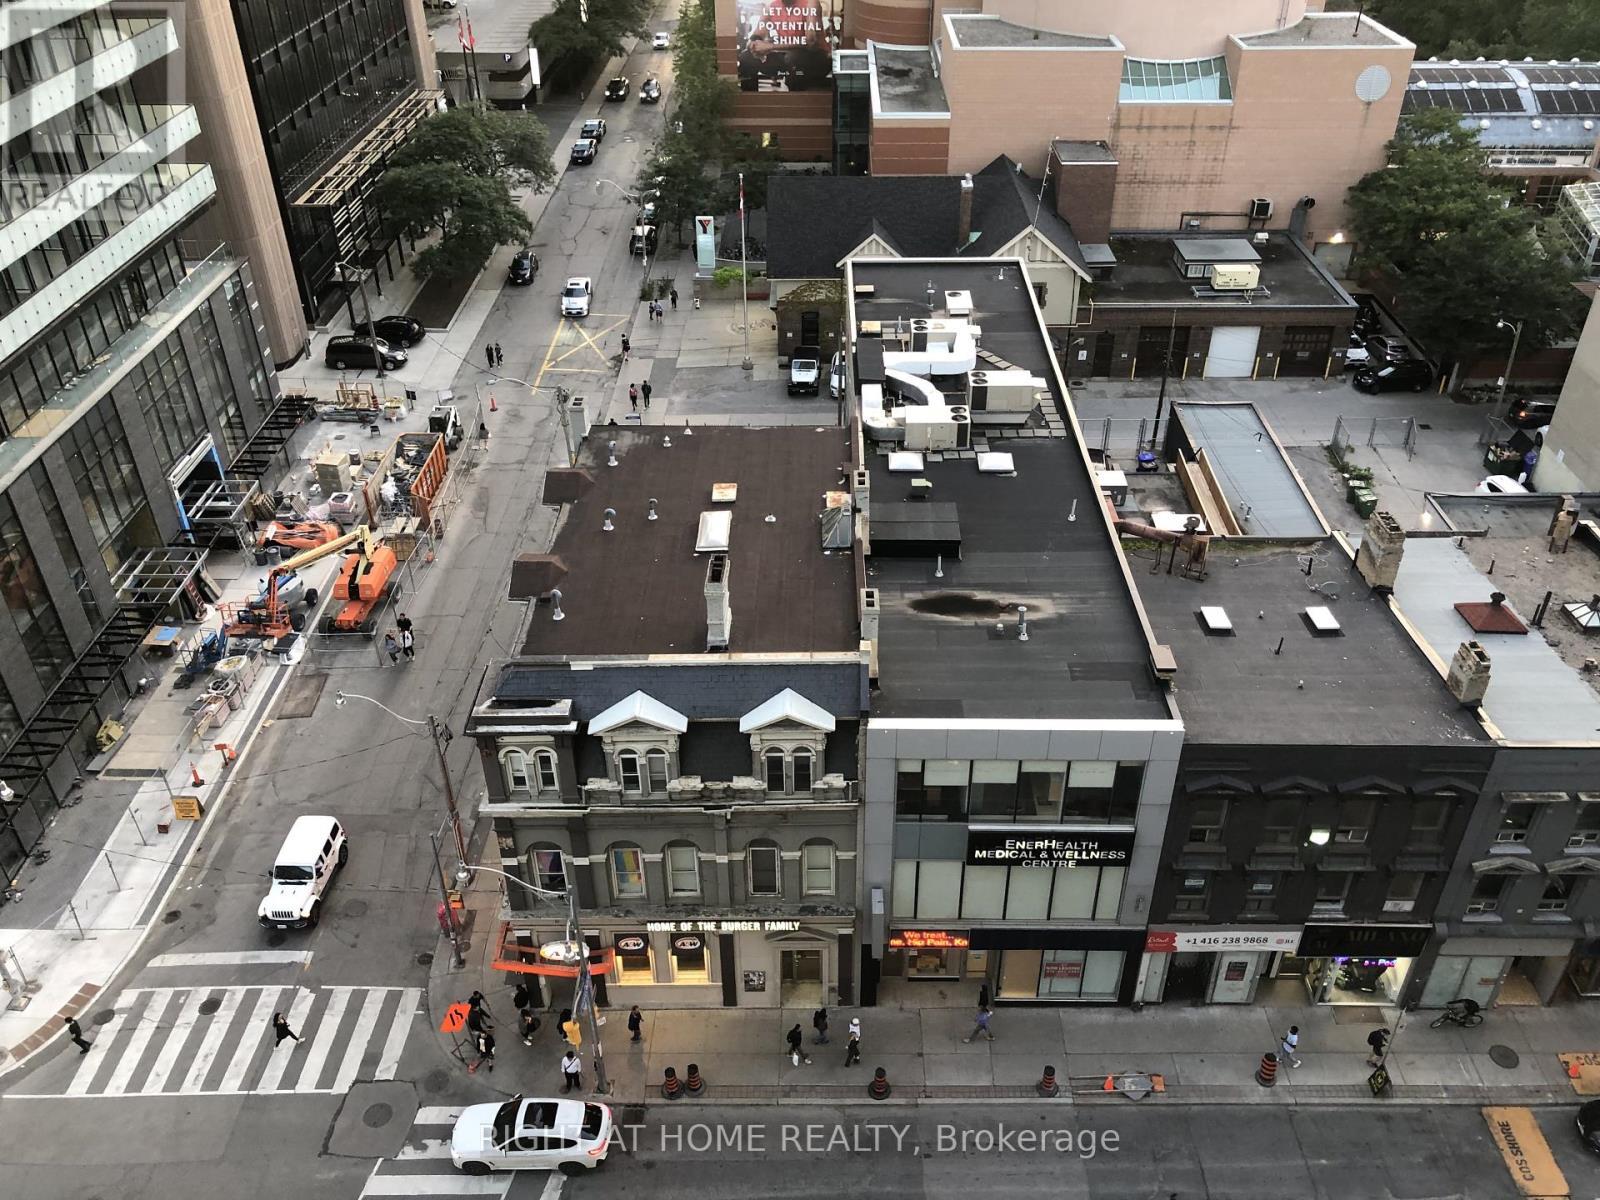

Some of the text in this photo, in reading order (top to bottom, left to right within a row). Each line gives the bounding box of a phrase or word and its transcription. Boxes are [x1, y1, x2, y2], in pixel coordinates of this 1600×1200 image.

[763, 7, 817, 16] LET YOUR
[759, 22, 821, 31] POTENTIAL
[773, 36, 807, 45] SHINE
[974, 850, 1126, 859] MEDICAL & WELLNESS
[1022, 860, 1077, 869] CENTRE
[646, 921, 800, 932] HOME OF THE BURGER FAMILY
[1200, 937, 1220, 945] 416
[1222, 937, 1241, 945] 238
[1243, 936, 1269, 944] 9868
